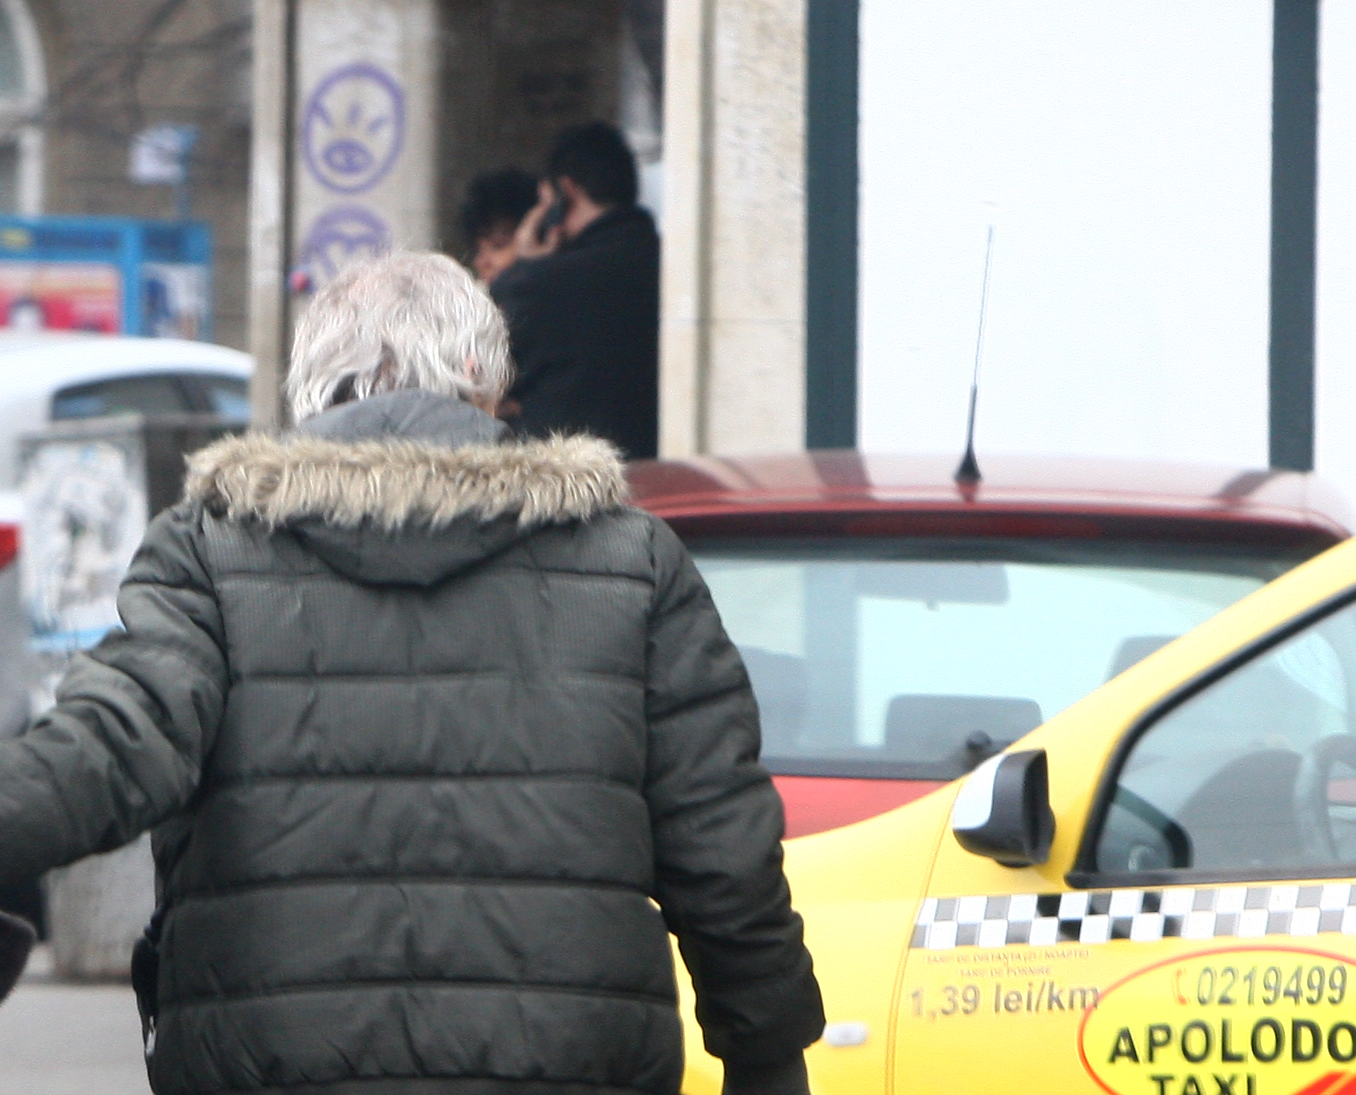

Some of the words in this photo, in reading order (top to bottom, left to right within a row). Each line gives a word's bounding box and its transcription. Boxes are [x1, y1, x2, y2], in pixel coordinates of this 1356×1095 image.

[911, 984, 981, 1019] 1,39
[994, 980, 1099, 1014] lei/km
[1197, 964, 1348, 1007] 0219499
[1108, 1017, 1356, 1064] APOLODO
